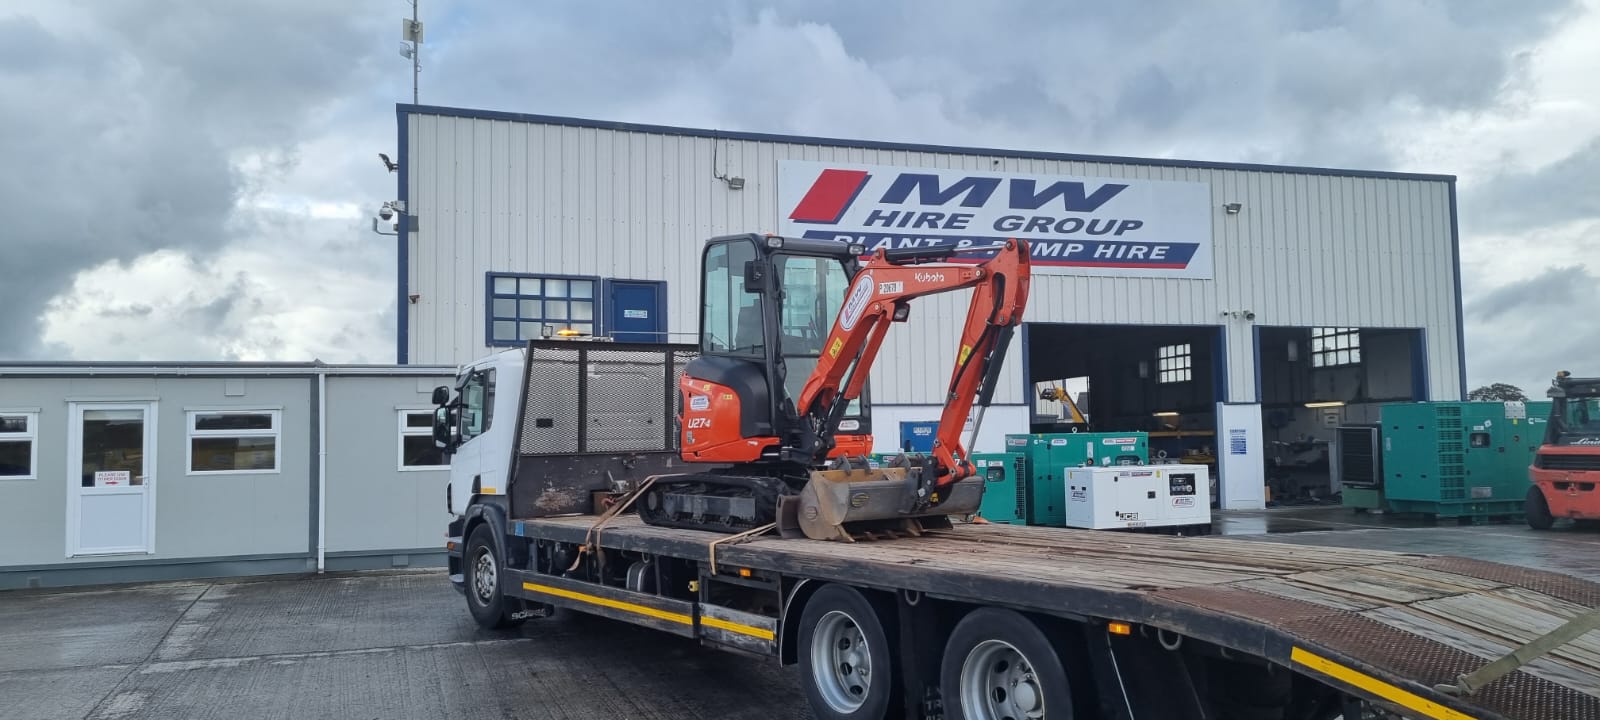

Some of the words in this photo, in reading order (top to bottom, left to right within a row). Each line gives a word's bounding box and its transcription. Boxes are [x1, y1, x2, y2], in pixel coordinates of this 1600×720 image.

[879, 173, 1129, 213] MW
[863, 209, 975, 230] HIRE
[993, 215, 1144, 236] GROUP
[987, 240, 1084, 257] MP
[1093, 244, 1170, 260] HIRE
[914, 272, 945, 283] Kubota
